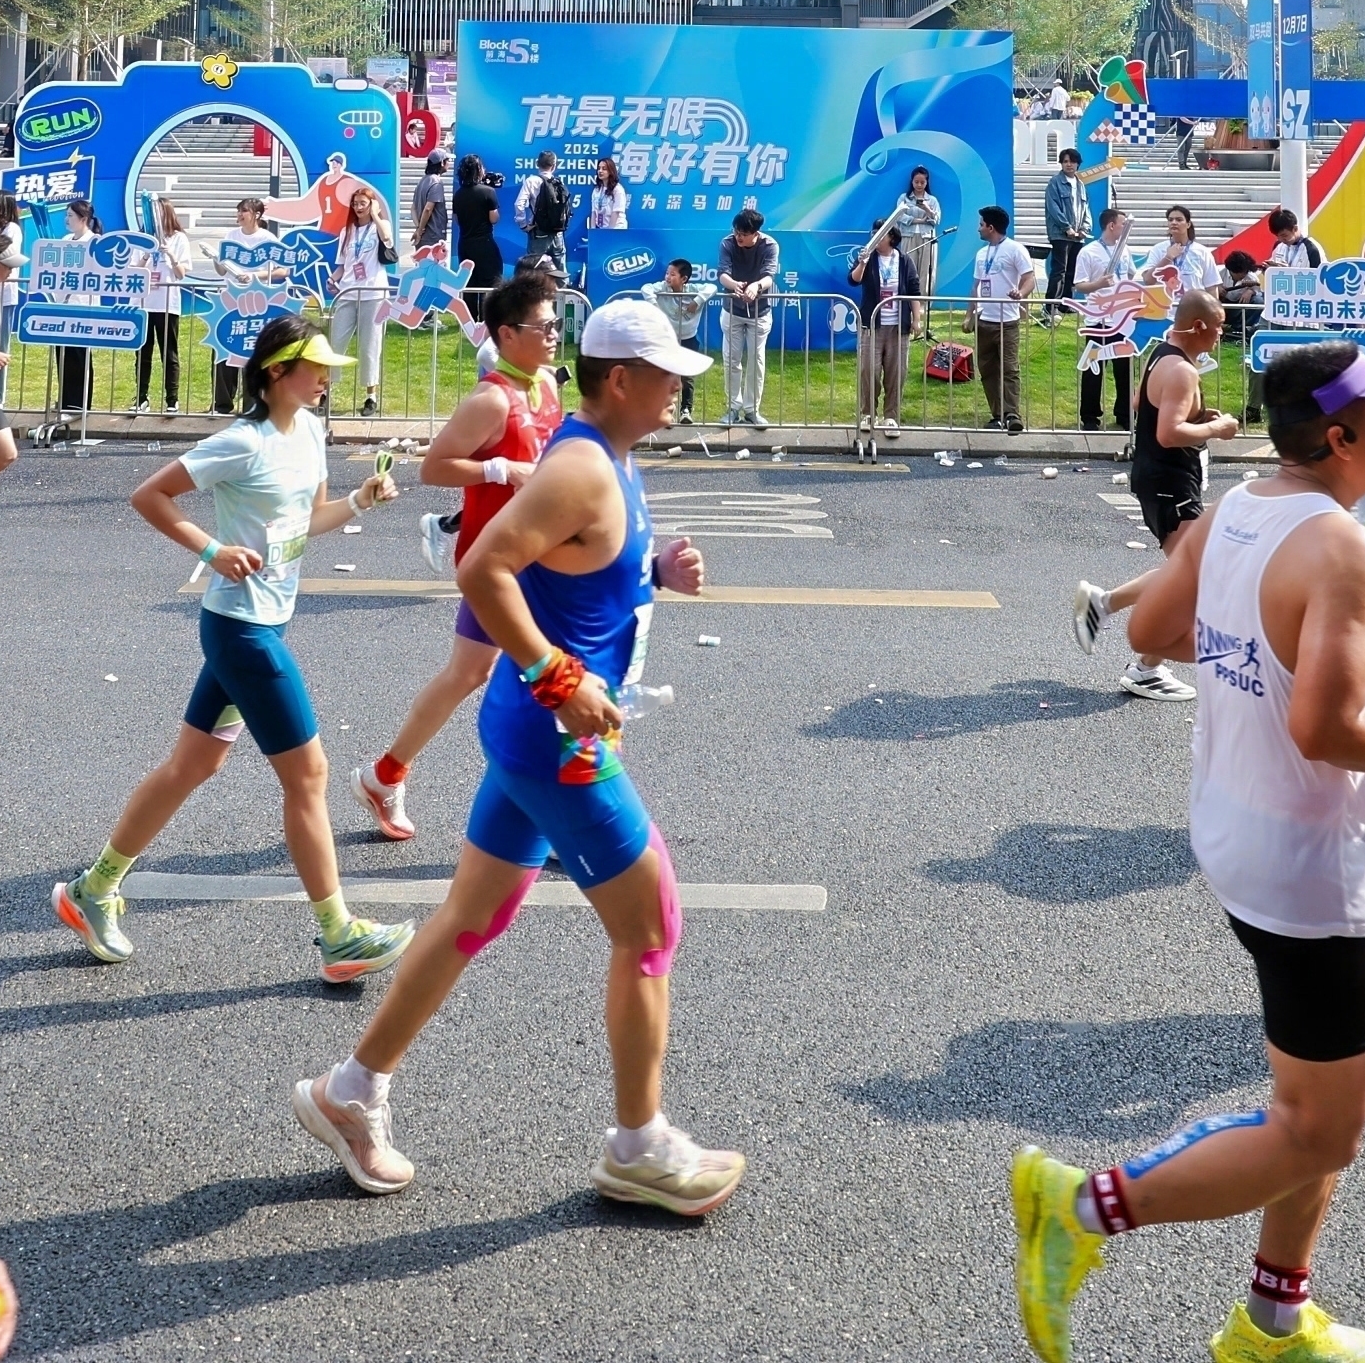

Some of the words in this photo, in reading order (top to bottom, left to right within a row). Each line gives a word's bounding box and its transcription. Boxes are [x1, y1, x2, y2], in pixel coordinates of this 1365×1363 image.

[1282, 14, 1307, 35] 12月7日
[479, 39, 509, 50] Block
[30, 107, 91, 137] RUN
[521, 94, 706, 145] 前景无限
[1282, 88, 1310, 139] SZ
[564, 144, 599, 155] 2025
[515, 158, 597, 170] SHZHEN
[610, 140, 789, 187] 海好有你
[15, 169, 77, 203] 热爱
[38, 243, 86, 268] 向前
[225, 245, 310, 265] 青春没有售价
[612, 253, 650, 273] RUN
[37, 270, 145, 293] 向海向未来
[1271, 271, 1317, 295] 向前
[31, 320, 65, 333] Lead
[70, 322, 93, 334] the
[97, 326, 131, 337] wave
[1215, 662, 1265, 697] PPSUC
